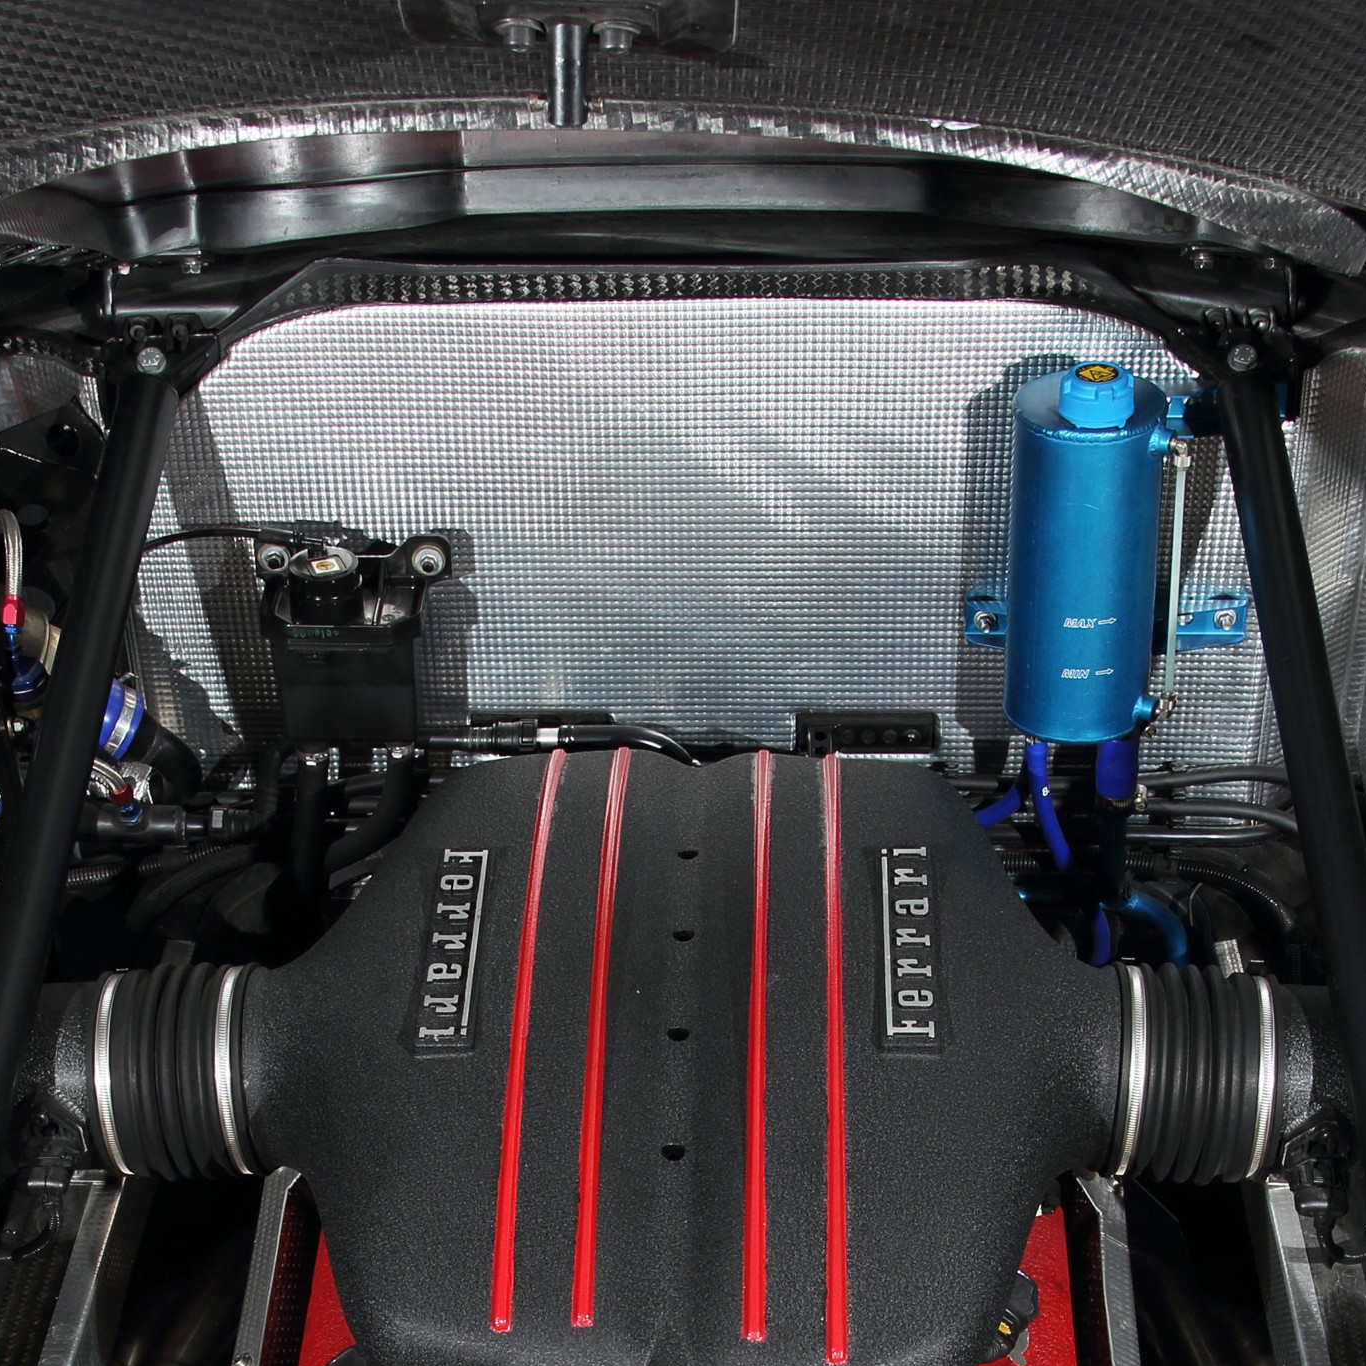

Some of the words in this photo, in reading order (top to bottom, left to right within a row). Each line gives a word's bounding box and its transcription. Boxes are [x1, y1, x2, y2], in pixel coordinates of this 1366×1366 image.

[1060, 668, 1091, 680] MIN
[1063, 616, 1097, 630] MAX
[418, 847, 489, 1039] Ferrari
[880, 845, 936, 1039] Ferrari
